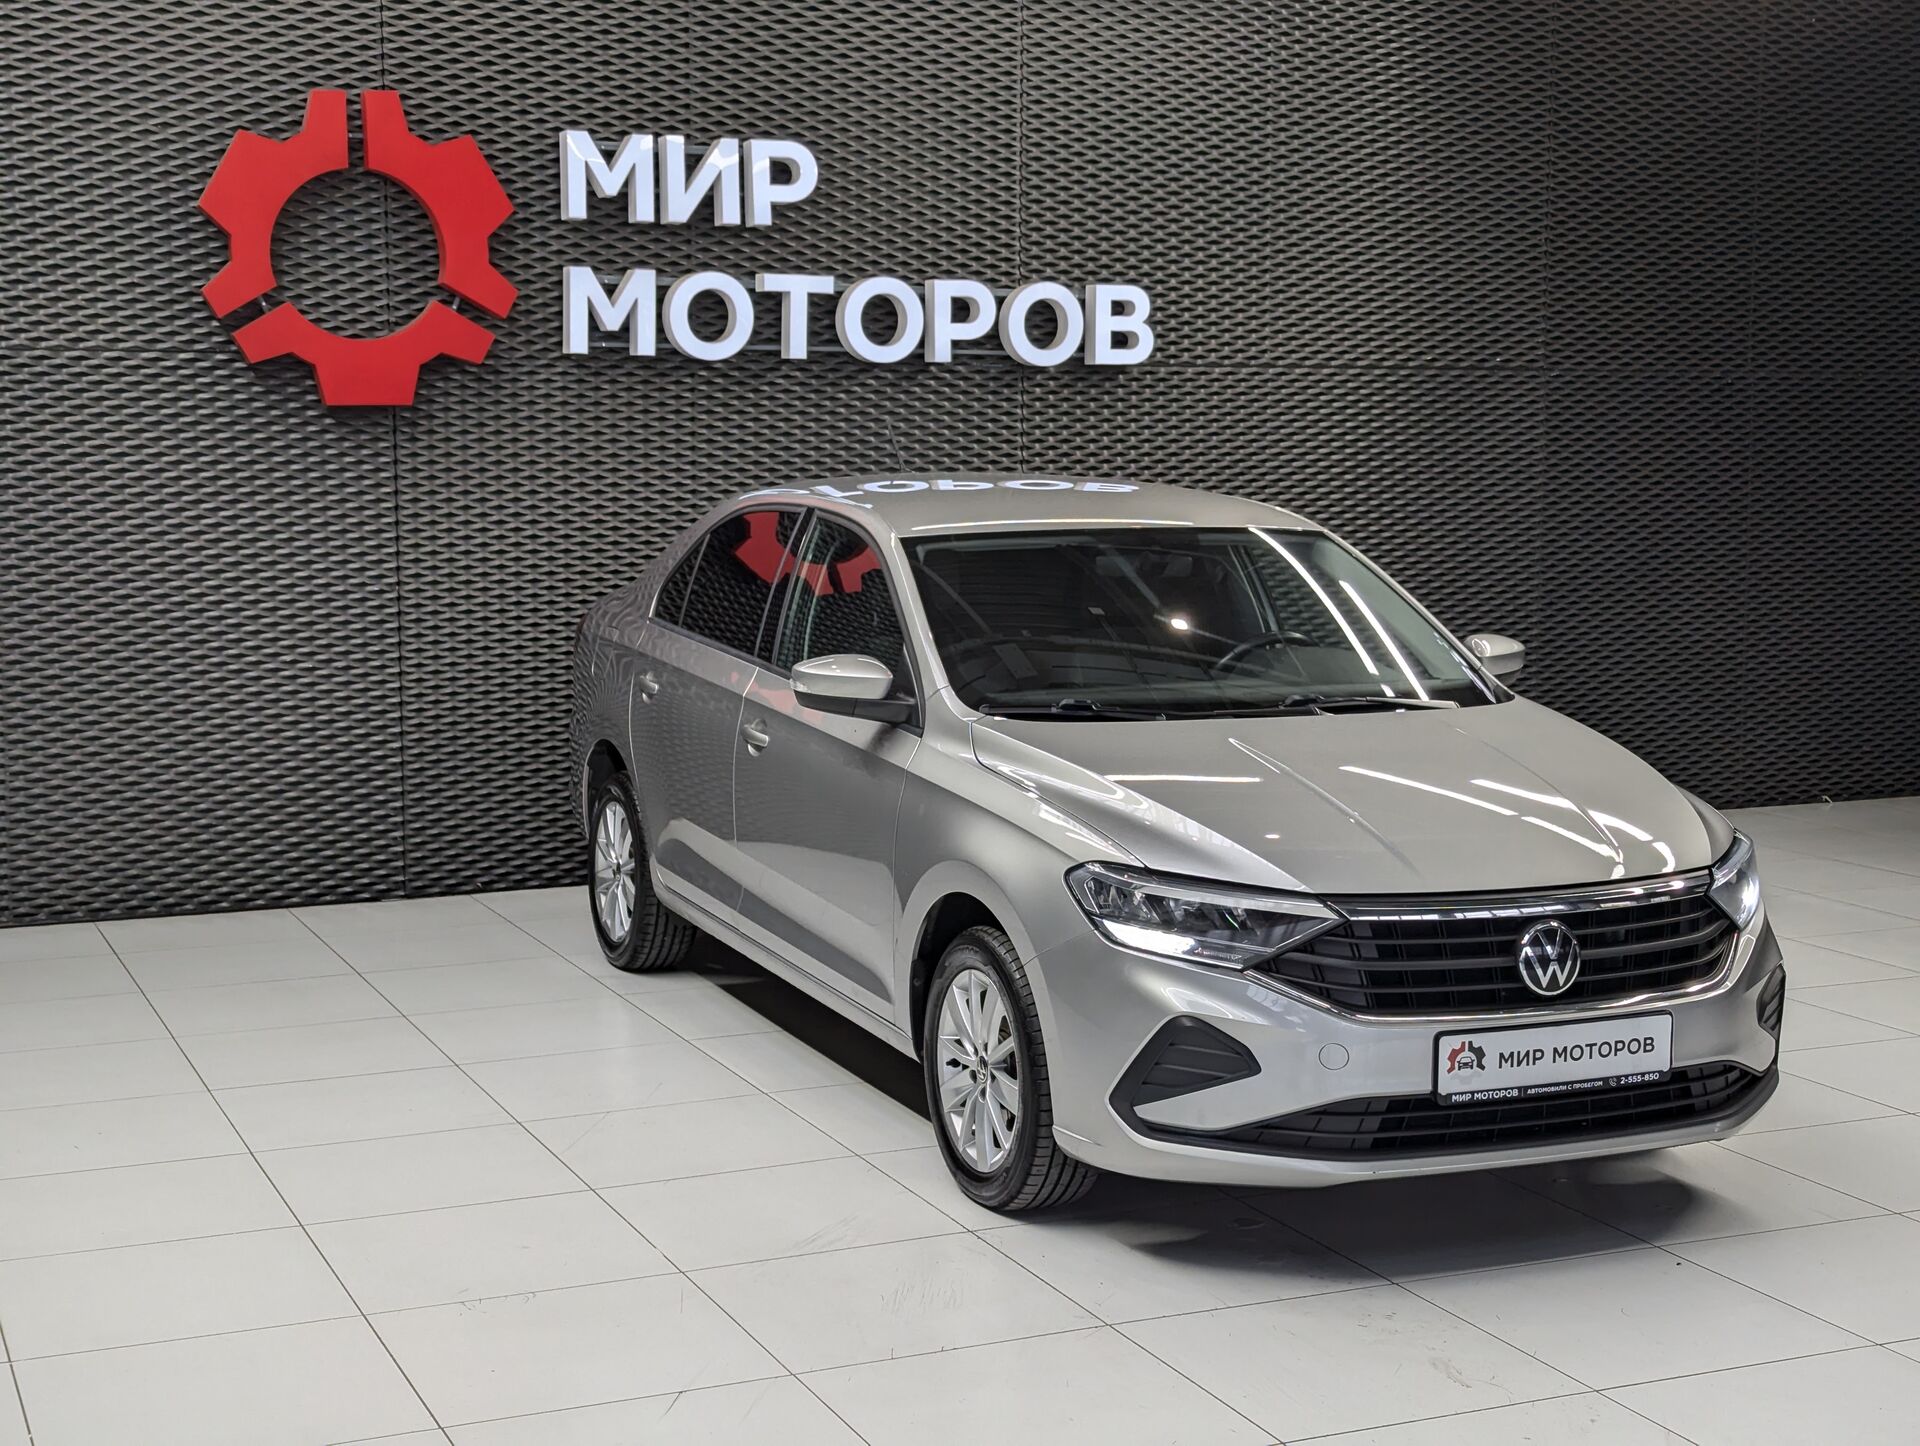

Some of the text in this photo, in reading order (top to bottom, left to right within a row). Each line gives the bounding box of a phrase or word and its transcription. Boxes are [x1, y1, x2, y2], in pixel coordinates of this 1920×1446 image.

[559, 130, 818, 227] МИР
[562, 266, 1155, 367] МОТОРОВ
[1498, 1036, 1656, 1070] МИР МОТОРОВ
[1451, 1093, 1472, 1103] МИР
[1473, 1088, 1519, 1101] МОТОРОВ
[1527, 1084, 1567, 1094] АВТОМОБИЛИ
[1572, 1080, 1603, 1090] ПРОБЕГОМ
[1620, 1072, 1659, 1084] 2-555-850
